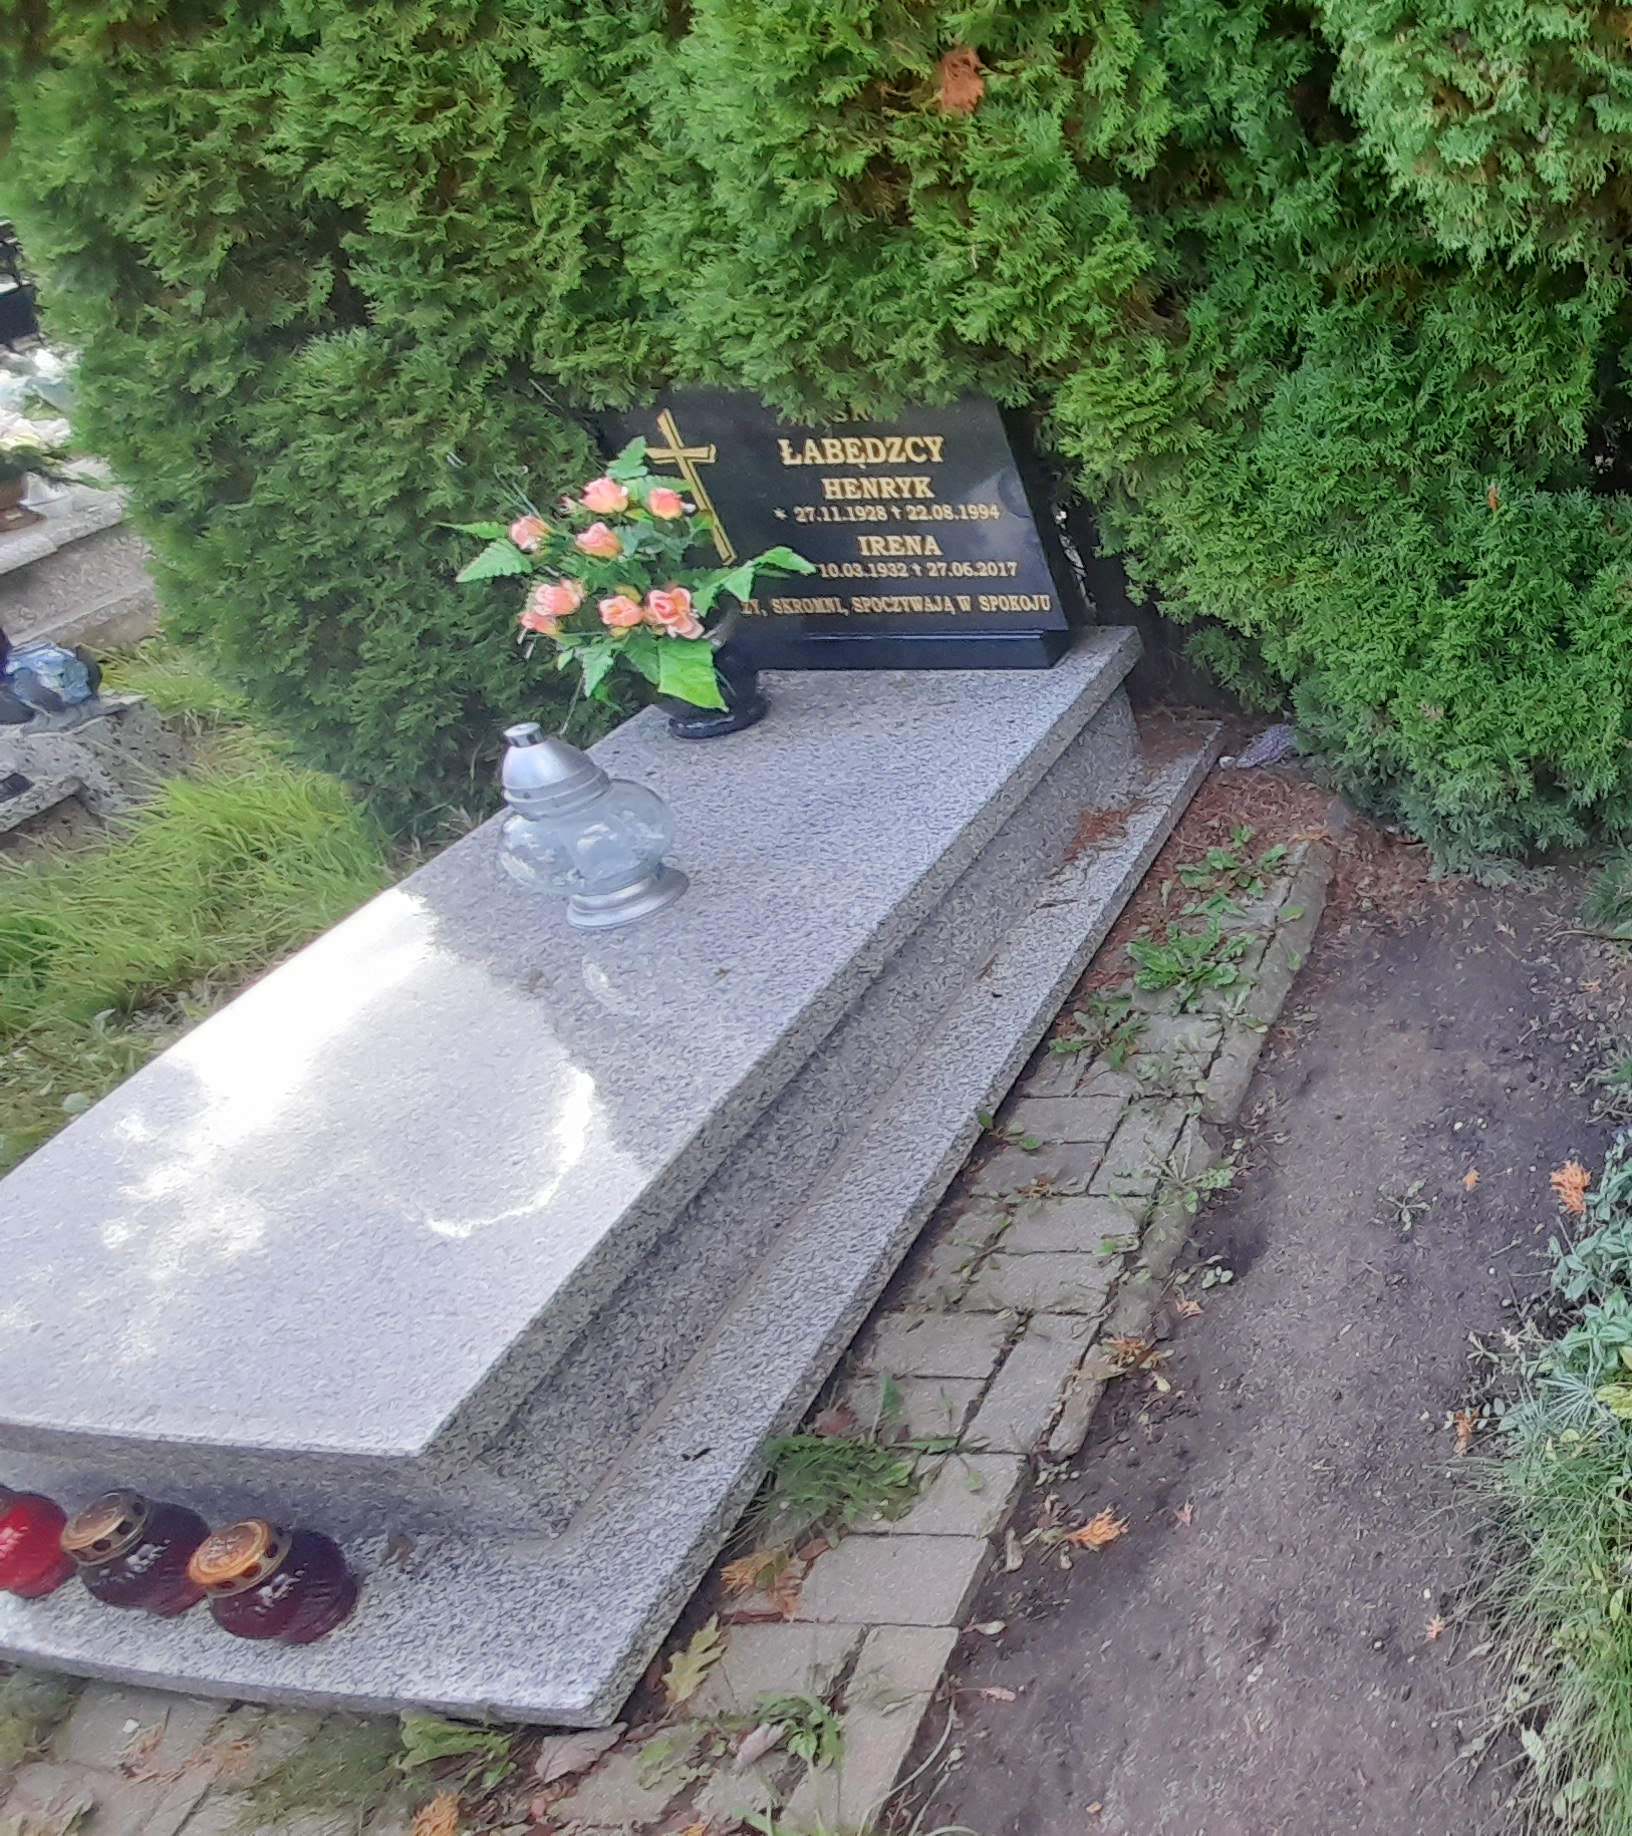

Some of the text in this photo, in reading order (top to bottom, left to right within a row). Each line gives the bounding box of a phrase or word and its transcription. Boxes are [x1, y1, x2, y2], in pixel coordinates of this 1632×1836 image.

[776, 435, 945, 469] ŁABĘDZCY
[821, 476, 935, 501] HENRYK
[793, 503, 1000, 523] 27.11.1928 22.08.1994
[857, 535, 944, 557] IRENA
[818, 561, 1018, 578] 10.03.1932 27.06.2017
[853, 595, 956, 615] SPOCZYWAJĄ
[958, 596, 972, 611] W
[978, 594, 1052, 612] SPOKOJU
